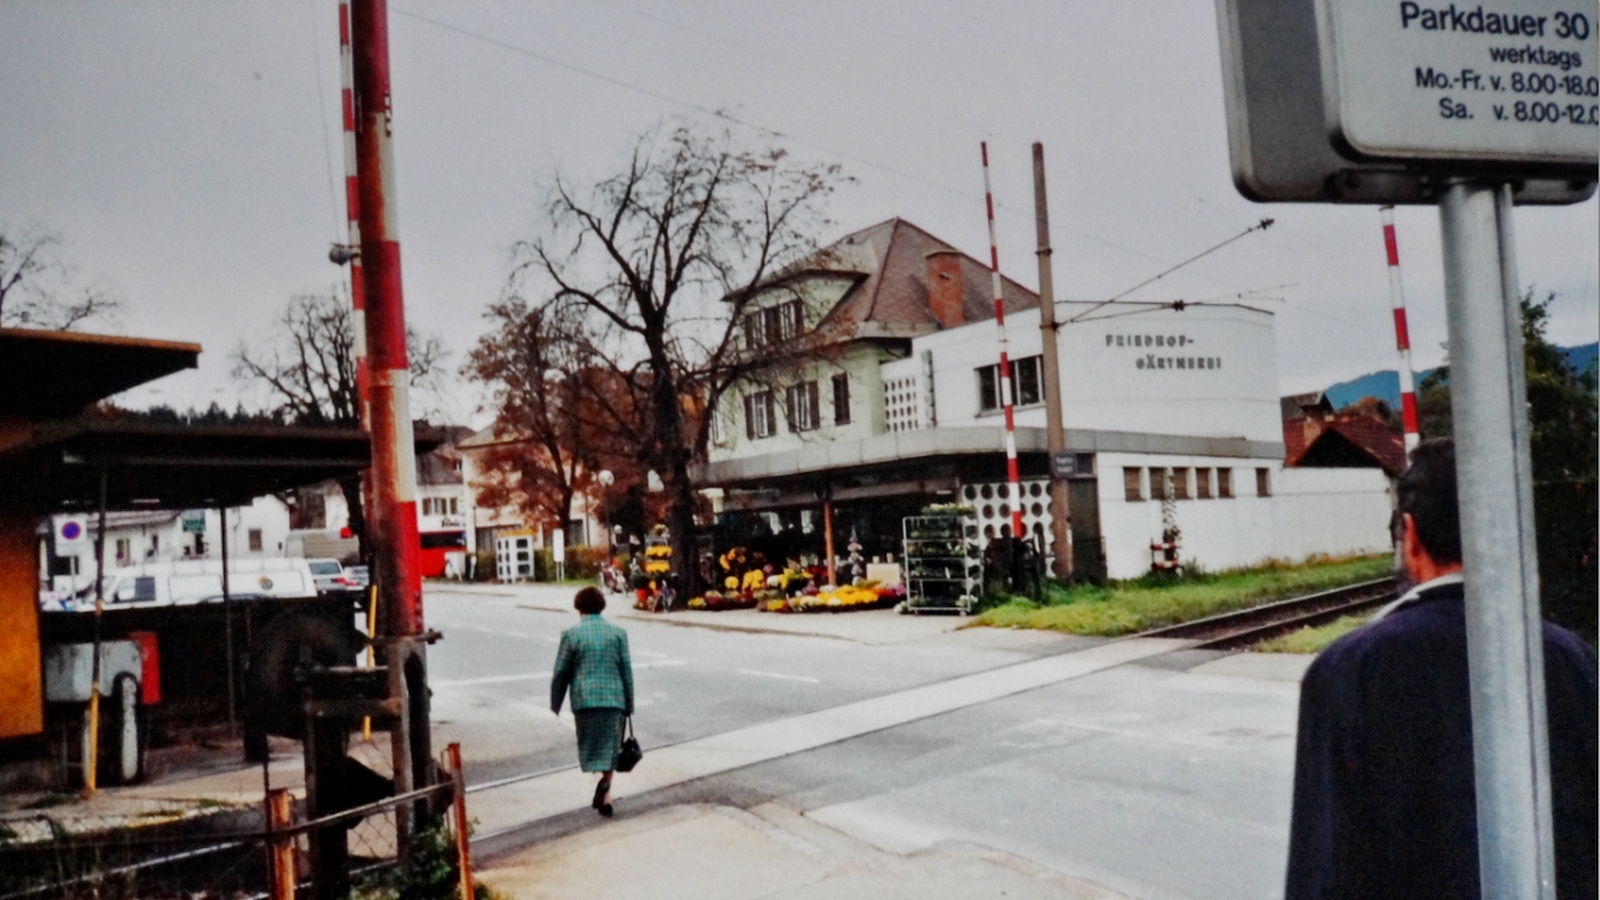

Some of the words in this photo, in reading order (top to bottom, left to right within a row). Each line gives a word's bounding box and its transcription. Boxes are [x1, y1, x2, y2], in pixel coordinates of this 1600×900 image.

[1400, 1, 1547, 37] Parkdauer
[1554, 11, 1590, 41] 30
[1490, 44, 1583, 71] werktags
[1415, 67, 1485, 91] Mo.-Fr.
[1490, 75, 1506, 91] v.
[1439, 97, 1475, 120] Sa.
[1493, 105, 1509, 120] v.
[1135, 354, 1222, 370] GÄRTNEREI
